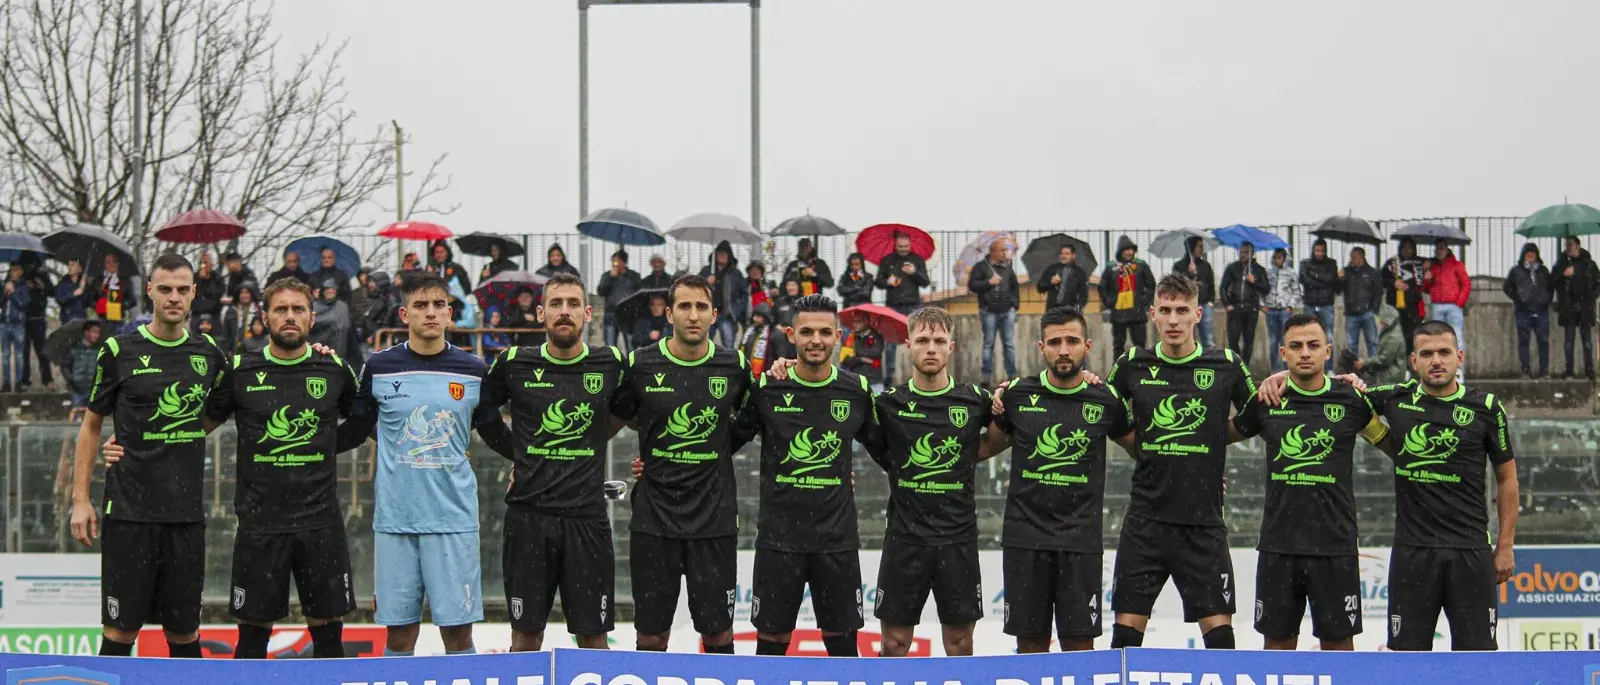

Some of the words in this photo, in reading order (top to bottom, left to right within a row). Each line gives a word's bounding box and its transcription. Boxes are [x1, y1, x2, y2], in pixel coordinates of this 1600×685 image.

[1221, 573, 1228, 589] 7
[601, 594, 607, 610] 6
[1089, 594, 1098, 609] 4
[1345, 595, 1357, 611] 20
